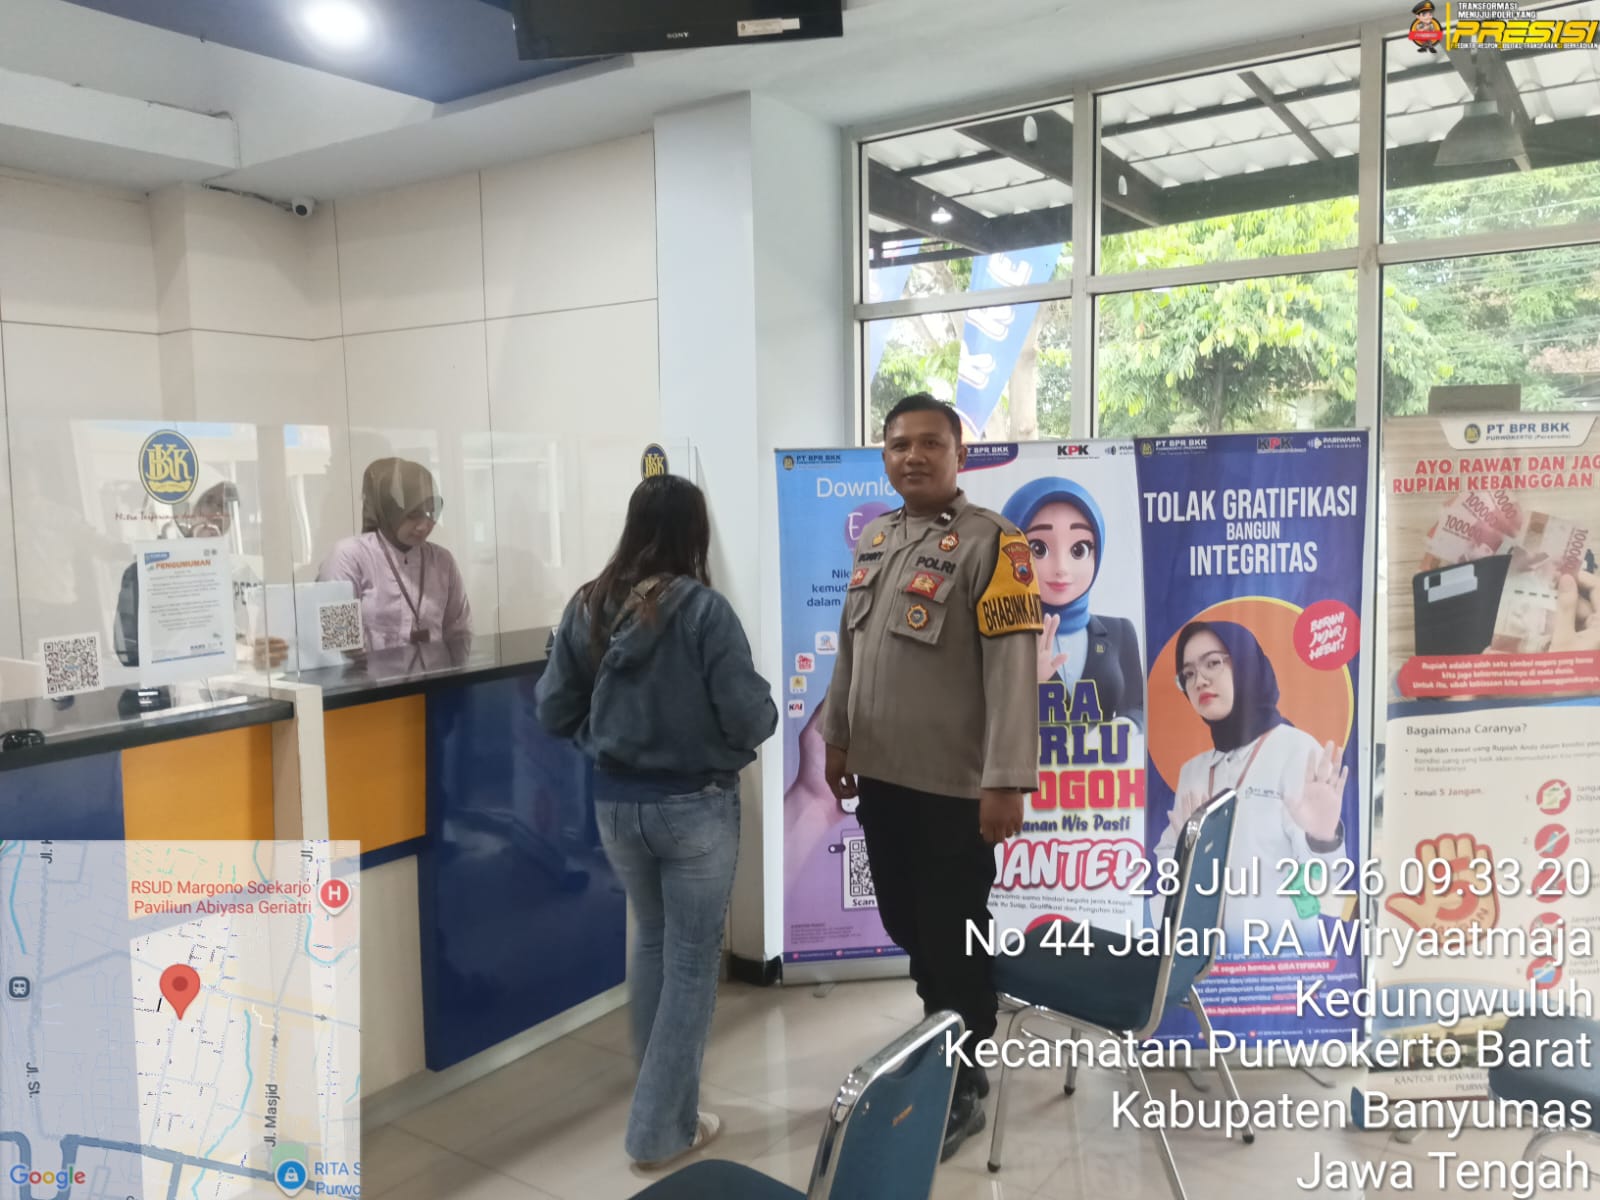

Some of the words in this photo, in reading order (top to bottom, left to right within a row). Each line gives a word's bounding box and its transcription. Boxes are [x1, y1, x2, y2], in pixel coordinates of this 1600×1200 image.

[667, 31, 689, 39] SONY
[1486, 423, 1505, 434] PT
[1509, 423, 1536, 433] BPR
[1541, 422, 1570, 432] BKK
[1057, 445, 1089, 456] KPK
[1188, 439, 1208, 447] BKK
[1257, 438, 1293, 450] KPK
[1415, 460, 1452, 474] AYO
[1459, 457, 1522, 474] RAWAT
[1528, 456, 1565, 470] DAN
[1393, 477, 1460, 493] RUPIAH
[1467, 473, 1593, 490] KEBANGGAAN
[1144, 489, 1216, 523] TOLAK
[1222, 485, 1358, 520] GRATIFIKASI
[1226, 520, 1281, 541] BANGUN
[155, 559, 212, 570] PENGUMUMAN
[915, 556, 957, 575] POLRI
[1190, 541, 1318, 577] INTEGRITAS
[806, 597, 841, 607] dalam
[1406, 725, 1471, 737] Bagaimana
[1474, 723, 1527, 735] Caranya?
[1039, 724, 1130, 765] RLU
[1031, 770, 1145, 809] OGOH
[1061, 814, 1088, 832] Wis
[1093, 814, 1131, 832] Pasti
[852, 898, 876, 907] Scan
